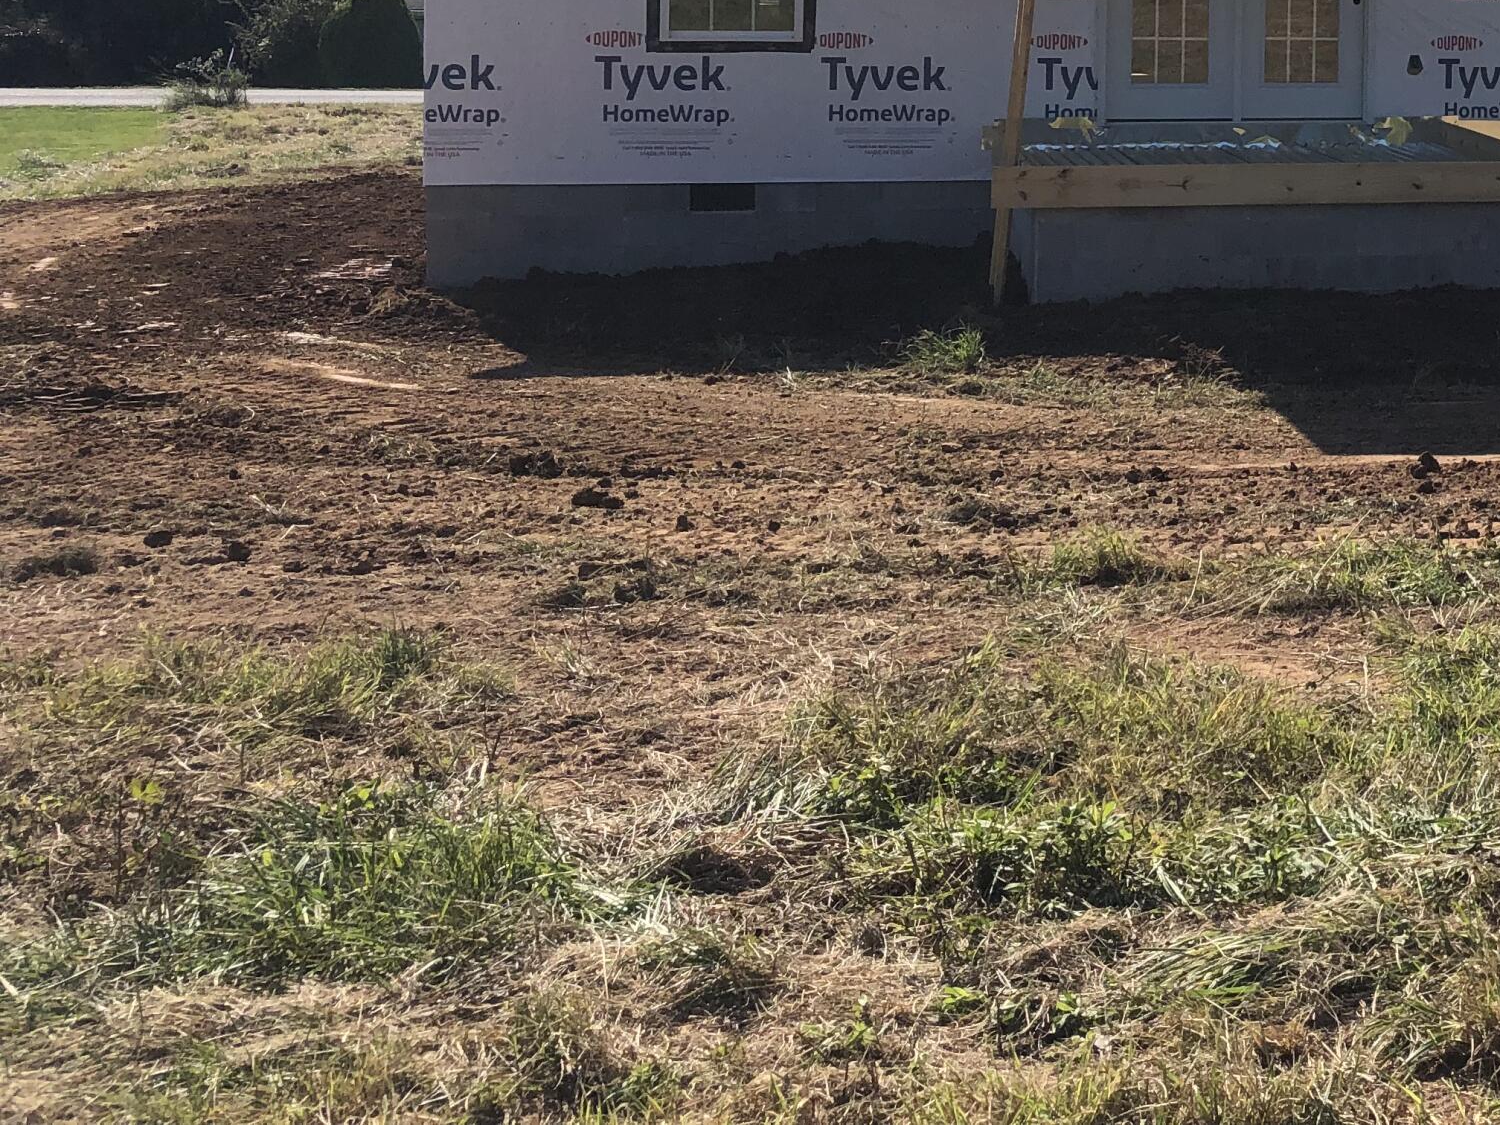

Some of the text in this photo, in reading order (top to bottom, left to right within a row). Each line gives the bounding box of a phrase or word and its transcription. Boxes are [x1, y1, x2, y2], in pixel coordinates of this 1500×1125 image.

[594, 31, 642, 48] DUPONT
[820, 33, 868, 48] DUPONT
[1037, 34, 1083, 50] DUPONT
[1437, 36, 1478, 51] DUPONT
[424, 55, 496, 91] vek
[595, 56, 726, 100] Tyvek
[821, 57, 946, 100] Tyvek
[1037, 57, 1098, 100] Tyv
[425, 105, 500, 127] eWrap
[603, 105, 730, 126] HomeWrap
[828, 105, 950, 126] HomeWrap
